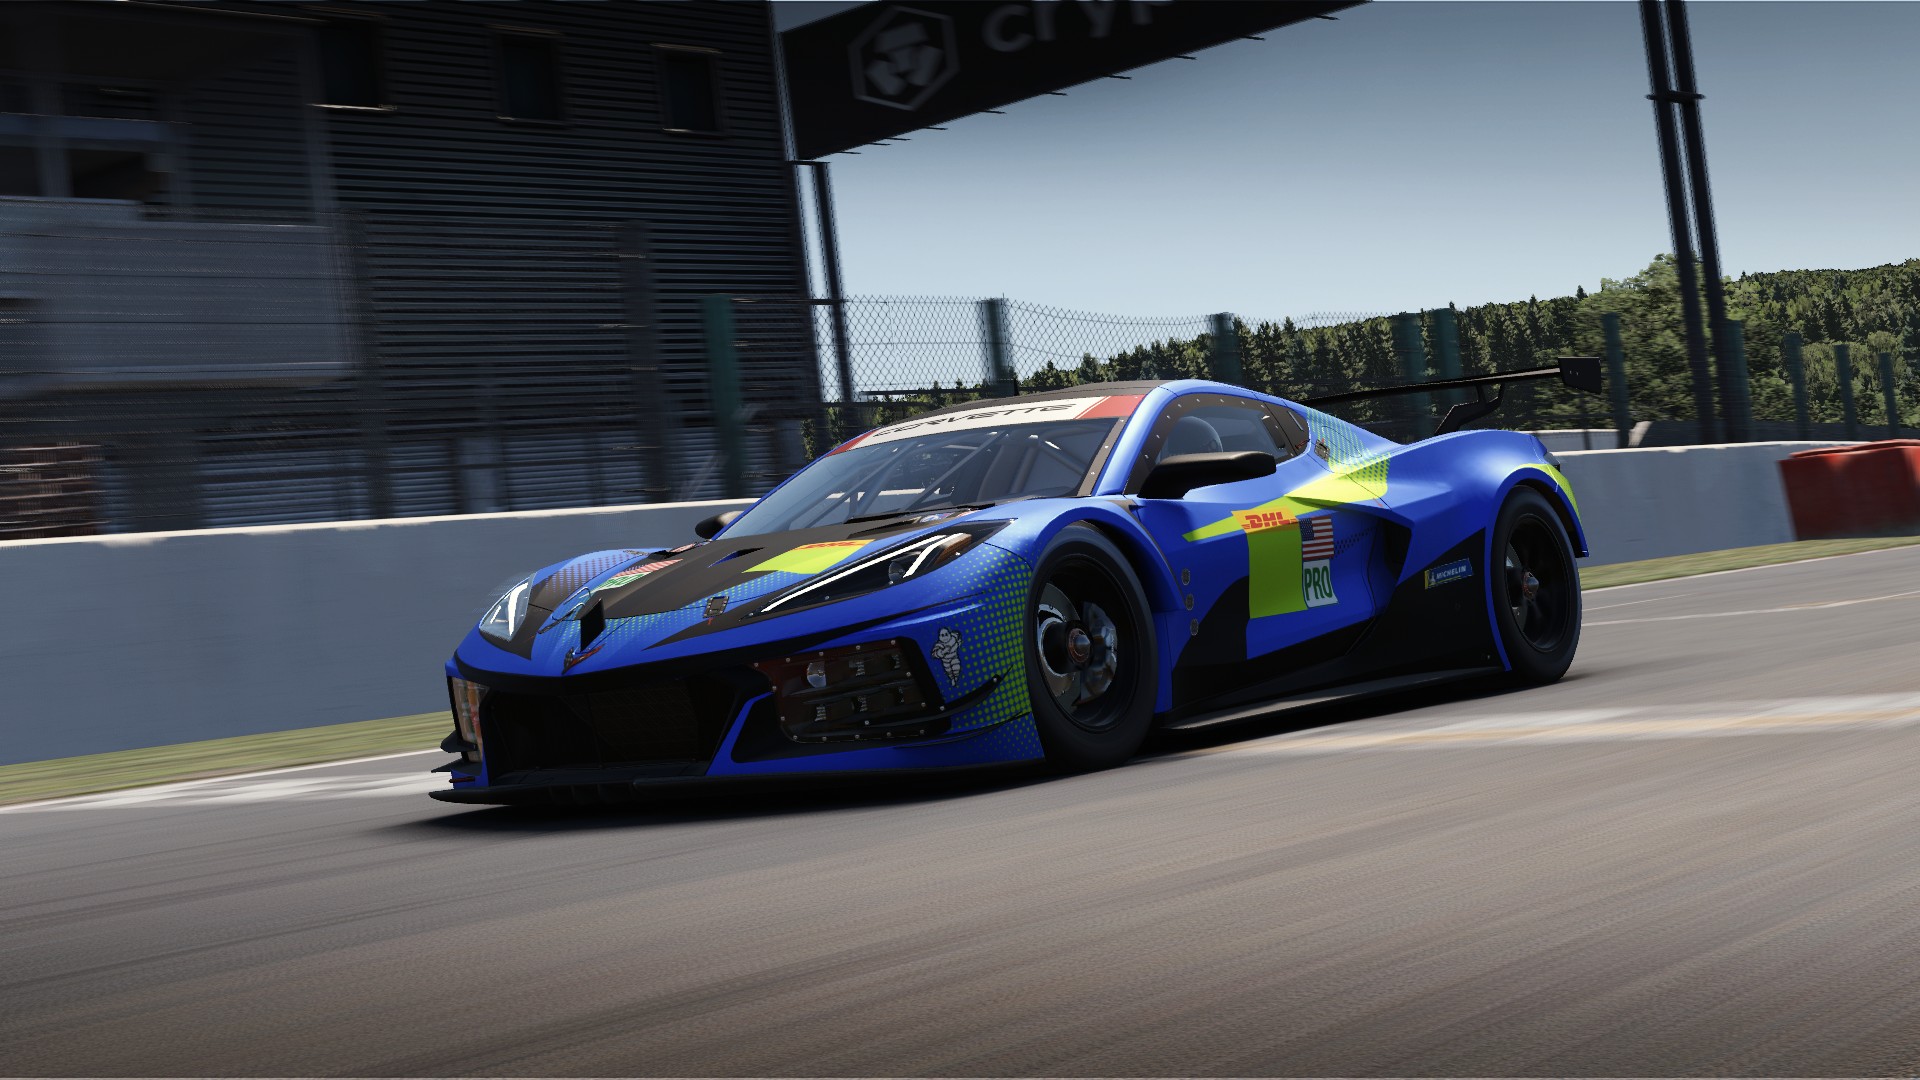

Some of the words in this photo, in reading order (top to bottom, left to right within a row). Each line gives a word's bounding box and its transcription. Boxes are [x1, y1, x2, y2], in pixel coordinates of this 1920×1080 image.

[1243, 511, 1293, 530] DHL
[1436, 565, 1467, 579] MICHELIN
[1304, 566, 1333, 601] PRO
